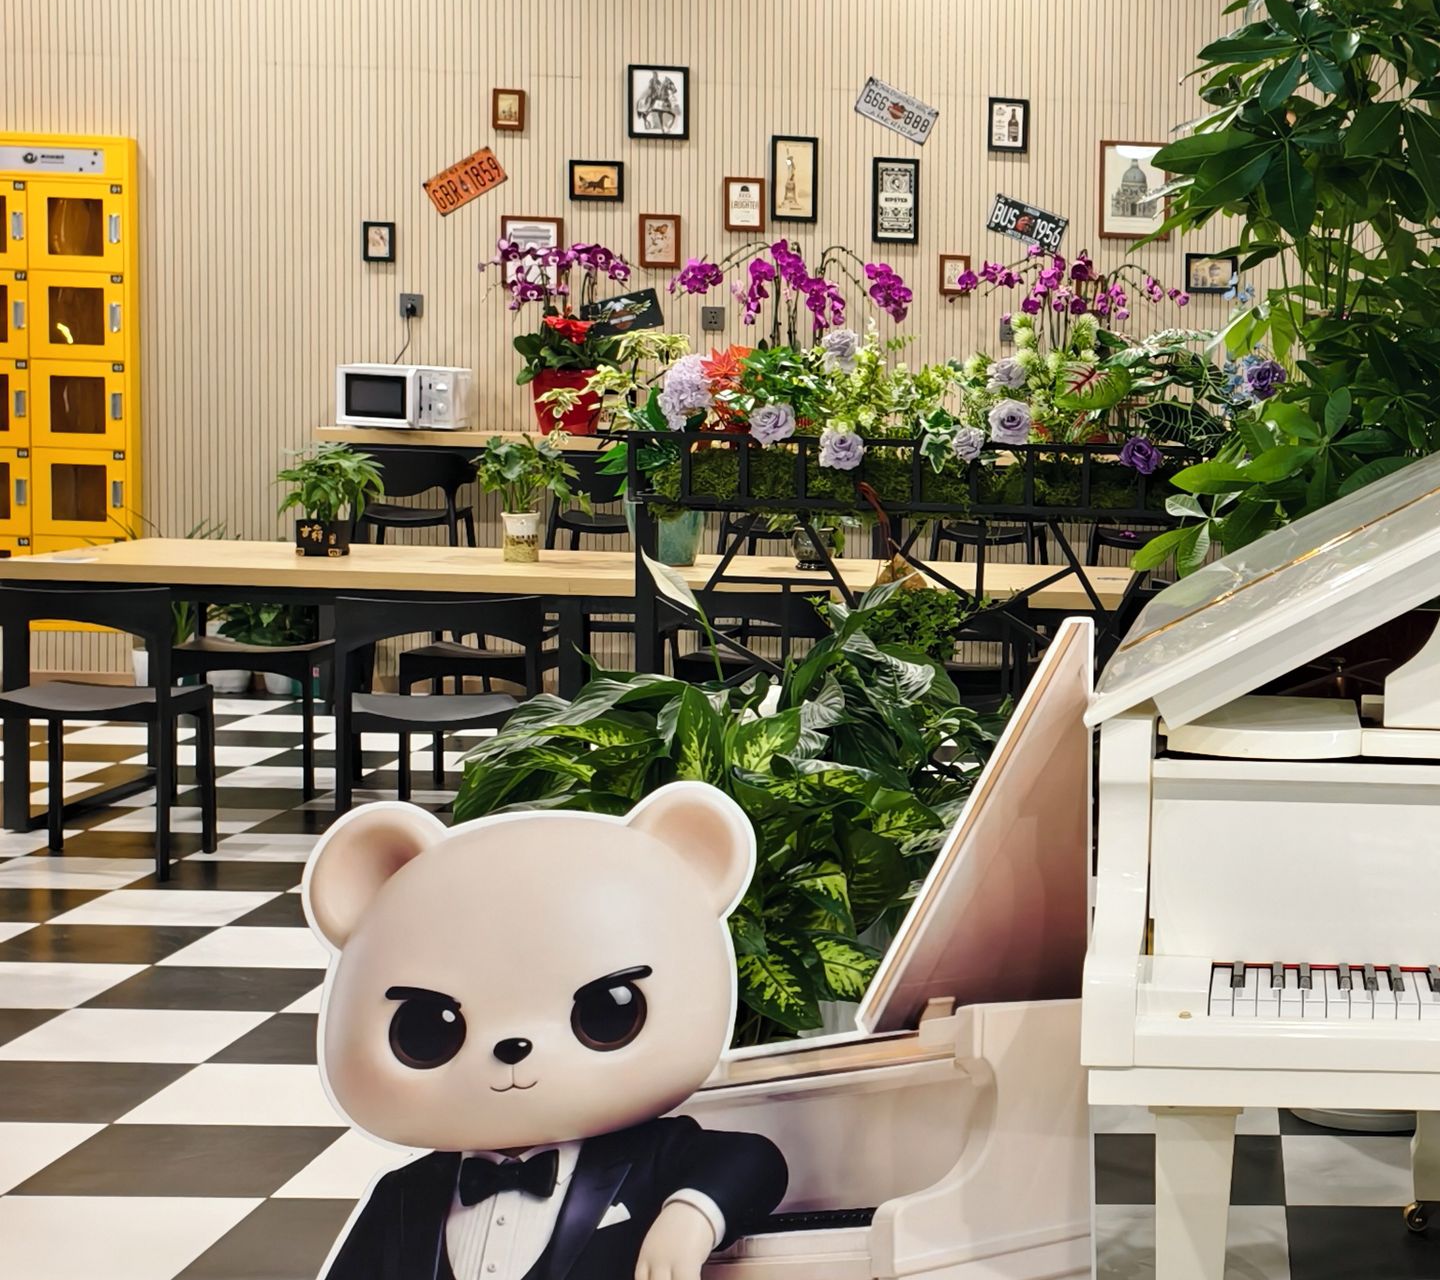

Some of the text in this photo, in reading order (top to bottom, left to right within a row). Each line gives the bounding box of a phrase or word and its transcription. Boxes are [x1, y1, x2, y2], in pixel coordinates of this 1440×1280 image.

[863, 88, 890, 111] 666
[903, 110, 930, 133] 888
[431, 179, 463, 210] GBR
[464, 156, 501, 191] 1859
[992, 202, 1062, 246] BUS 1956
